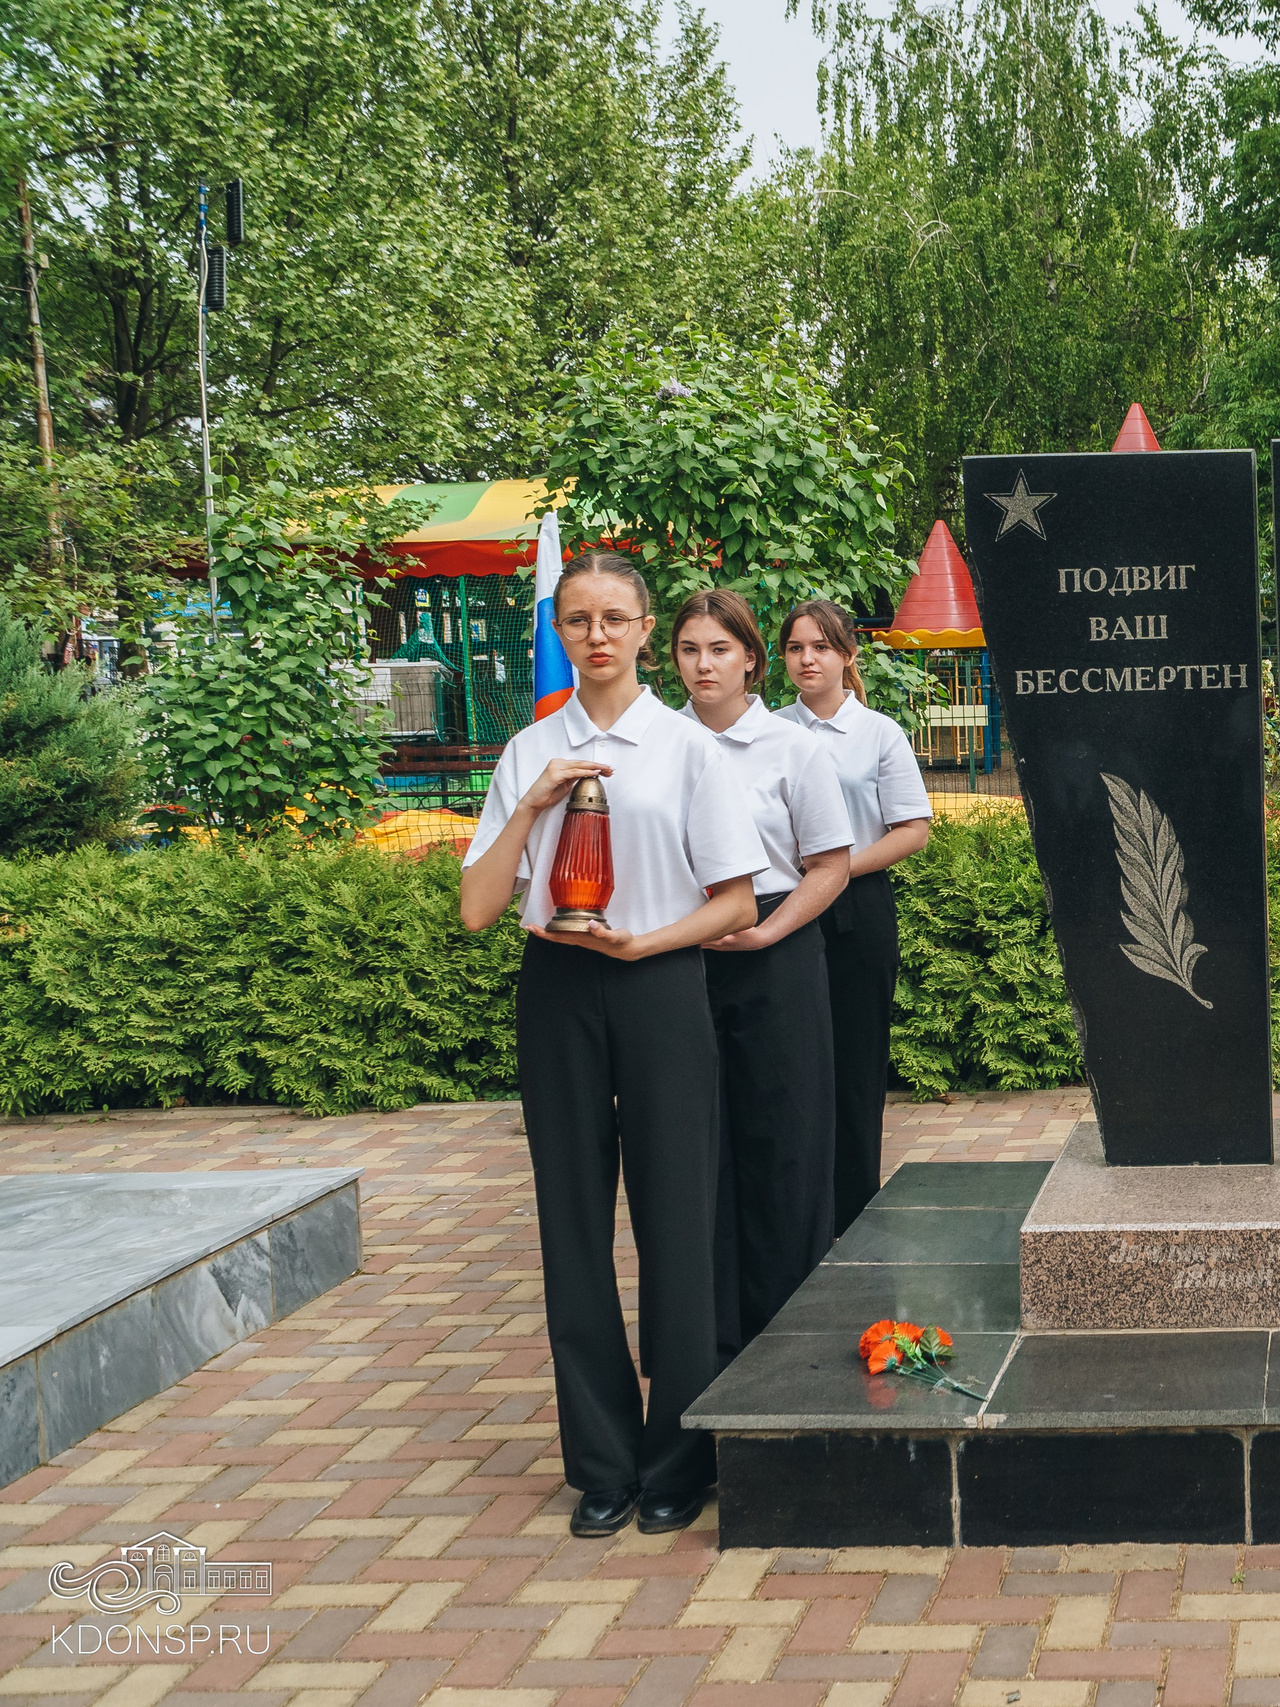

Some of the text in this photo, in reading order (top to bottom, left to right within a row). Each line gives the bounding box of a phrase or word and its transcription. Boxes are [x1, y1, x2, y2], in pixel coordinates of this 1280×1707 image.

[1057, 564, 1196, 597] ПОДВИГ
[1088, 614, 1169, 642] ВАШ
[1015, 663, 1248, 695] БЕССМЕРТЕН
